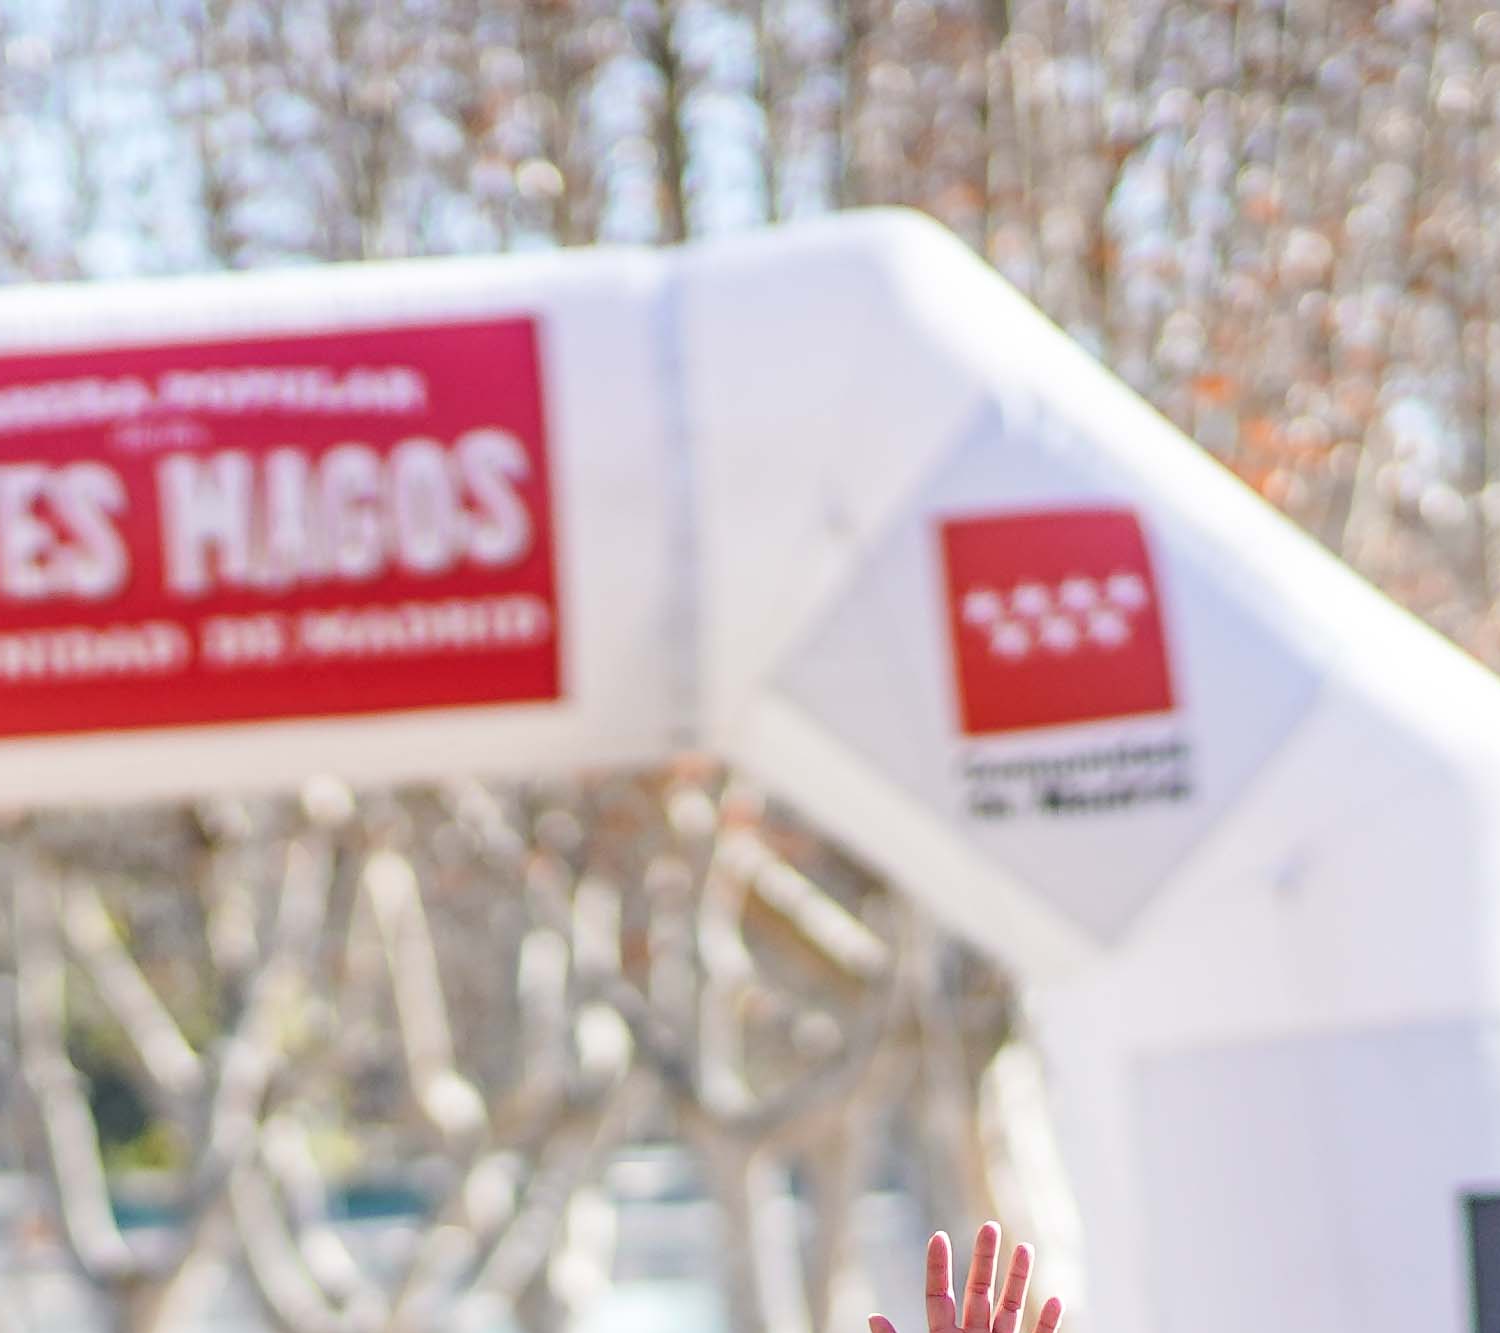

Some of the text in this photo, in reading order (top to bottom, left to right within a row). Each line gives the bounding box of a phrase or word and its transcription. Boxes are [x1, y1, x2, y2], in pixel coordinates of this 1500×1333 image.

[155, 426, 532, 598] MAGOS
[206, 617, 281, 666] DE
[306, 599, 545, 654] MADRID
